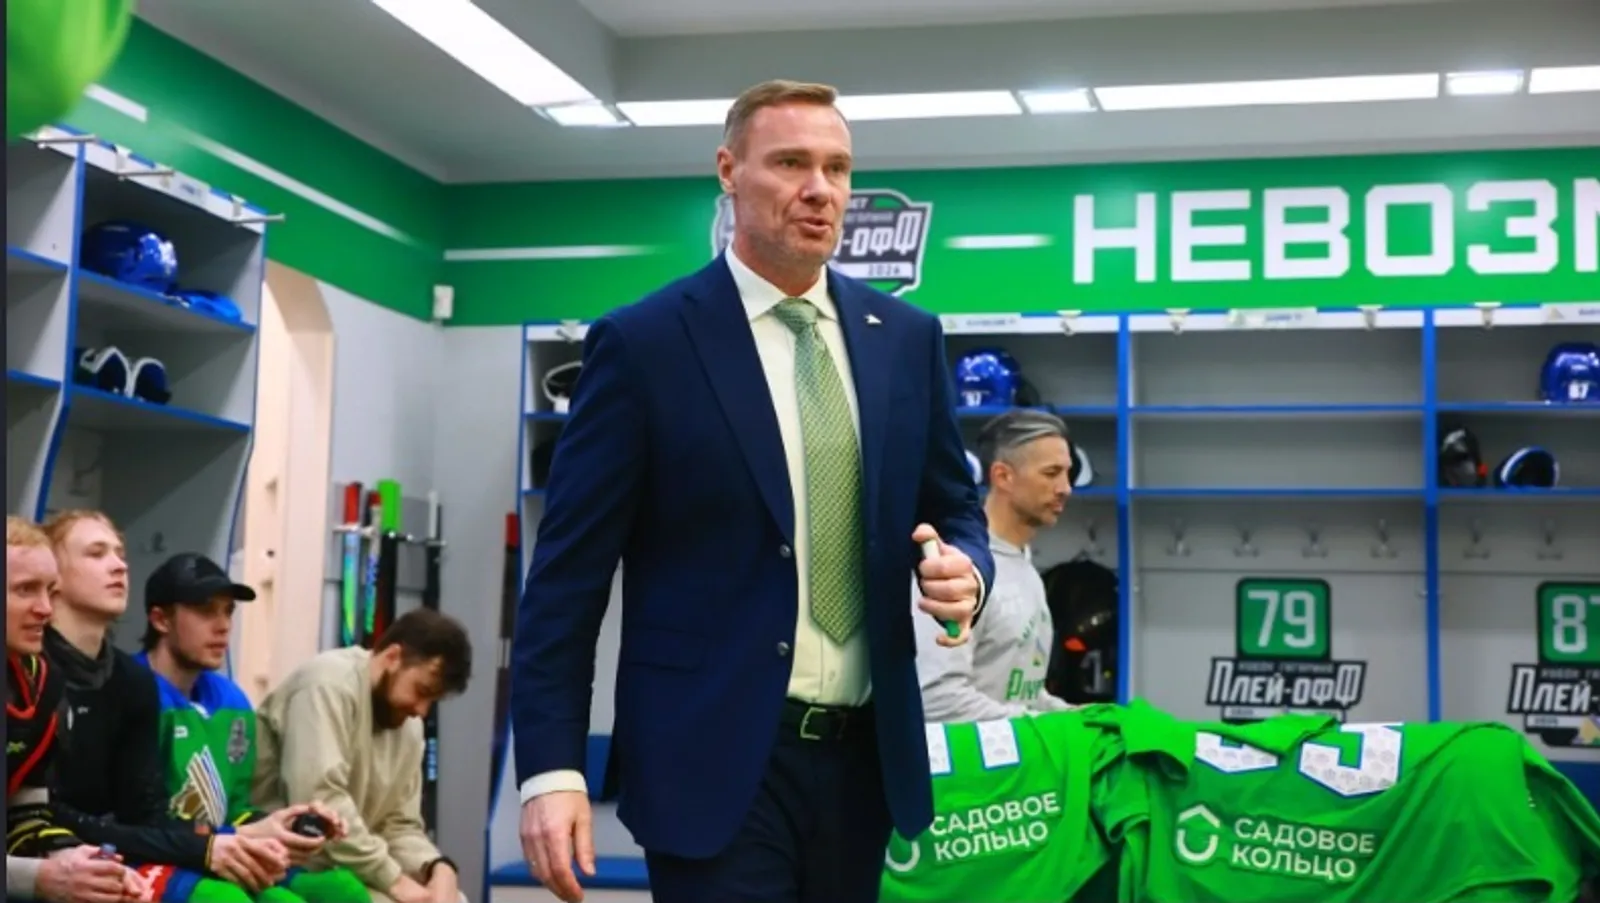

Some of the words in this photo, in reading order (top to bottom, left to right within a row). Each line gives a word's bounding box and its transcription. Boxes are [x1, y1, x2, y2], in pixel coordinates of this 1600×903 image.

[1073, 179, 1600, 285] НЕВОЗ
[1247, 589, 1317, 649] 79
[1552, 594, 1600, 653] 8
[1511, 667, 1600, 713] ПЛЕЙ-
[930, 791, 1061, 837] САДОВОЕ
[1234, 817, 1375, 855] САДОВОЕ
[934, 820, 1049, 863] КОЛЬЦО
[1231, 843, 1357, 881] КОЛЬЦО
